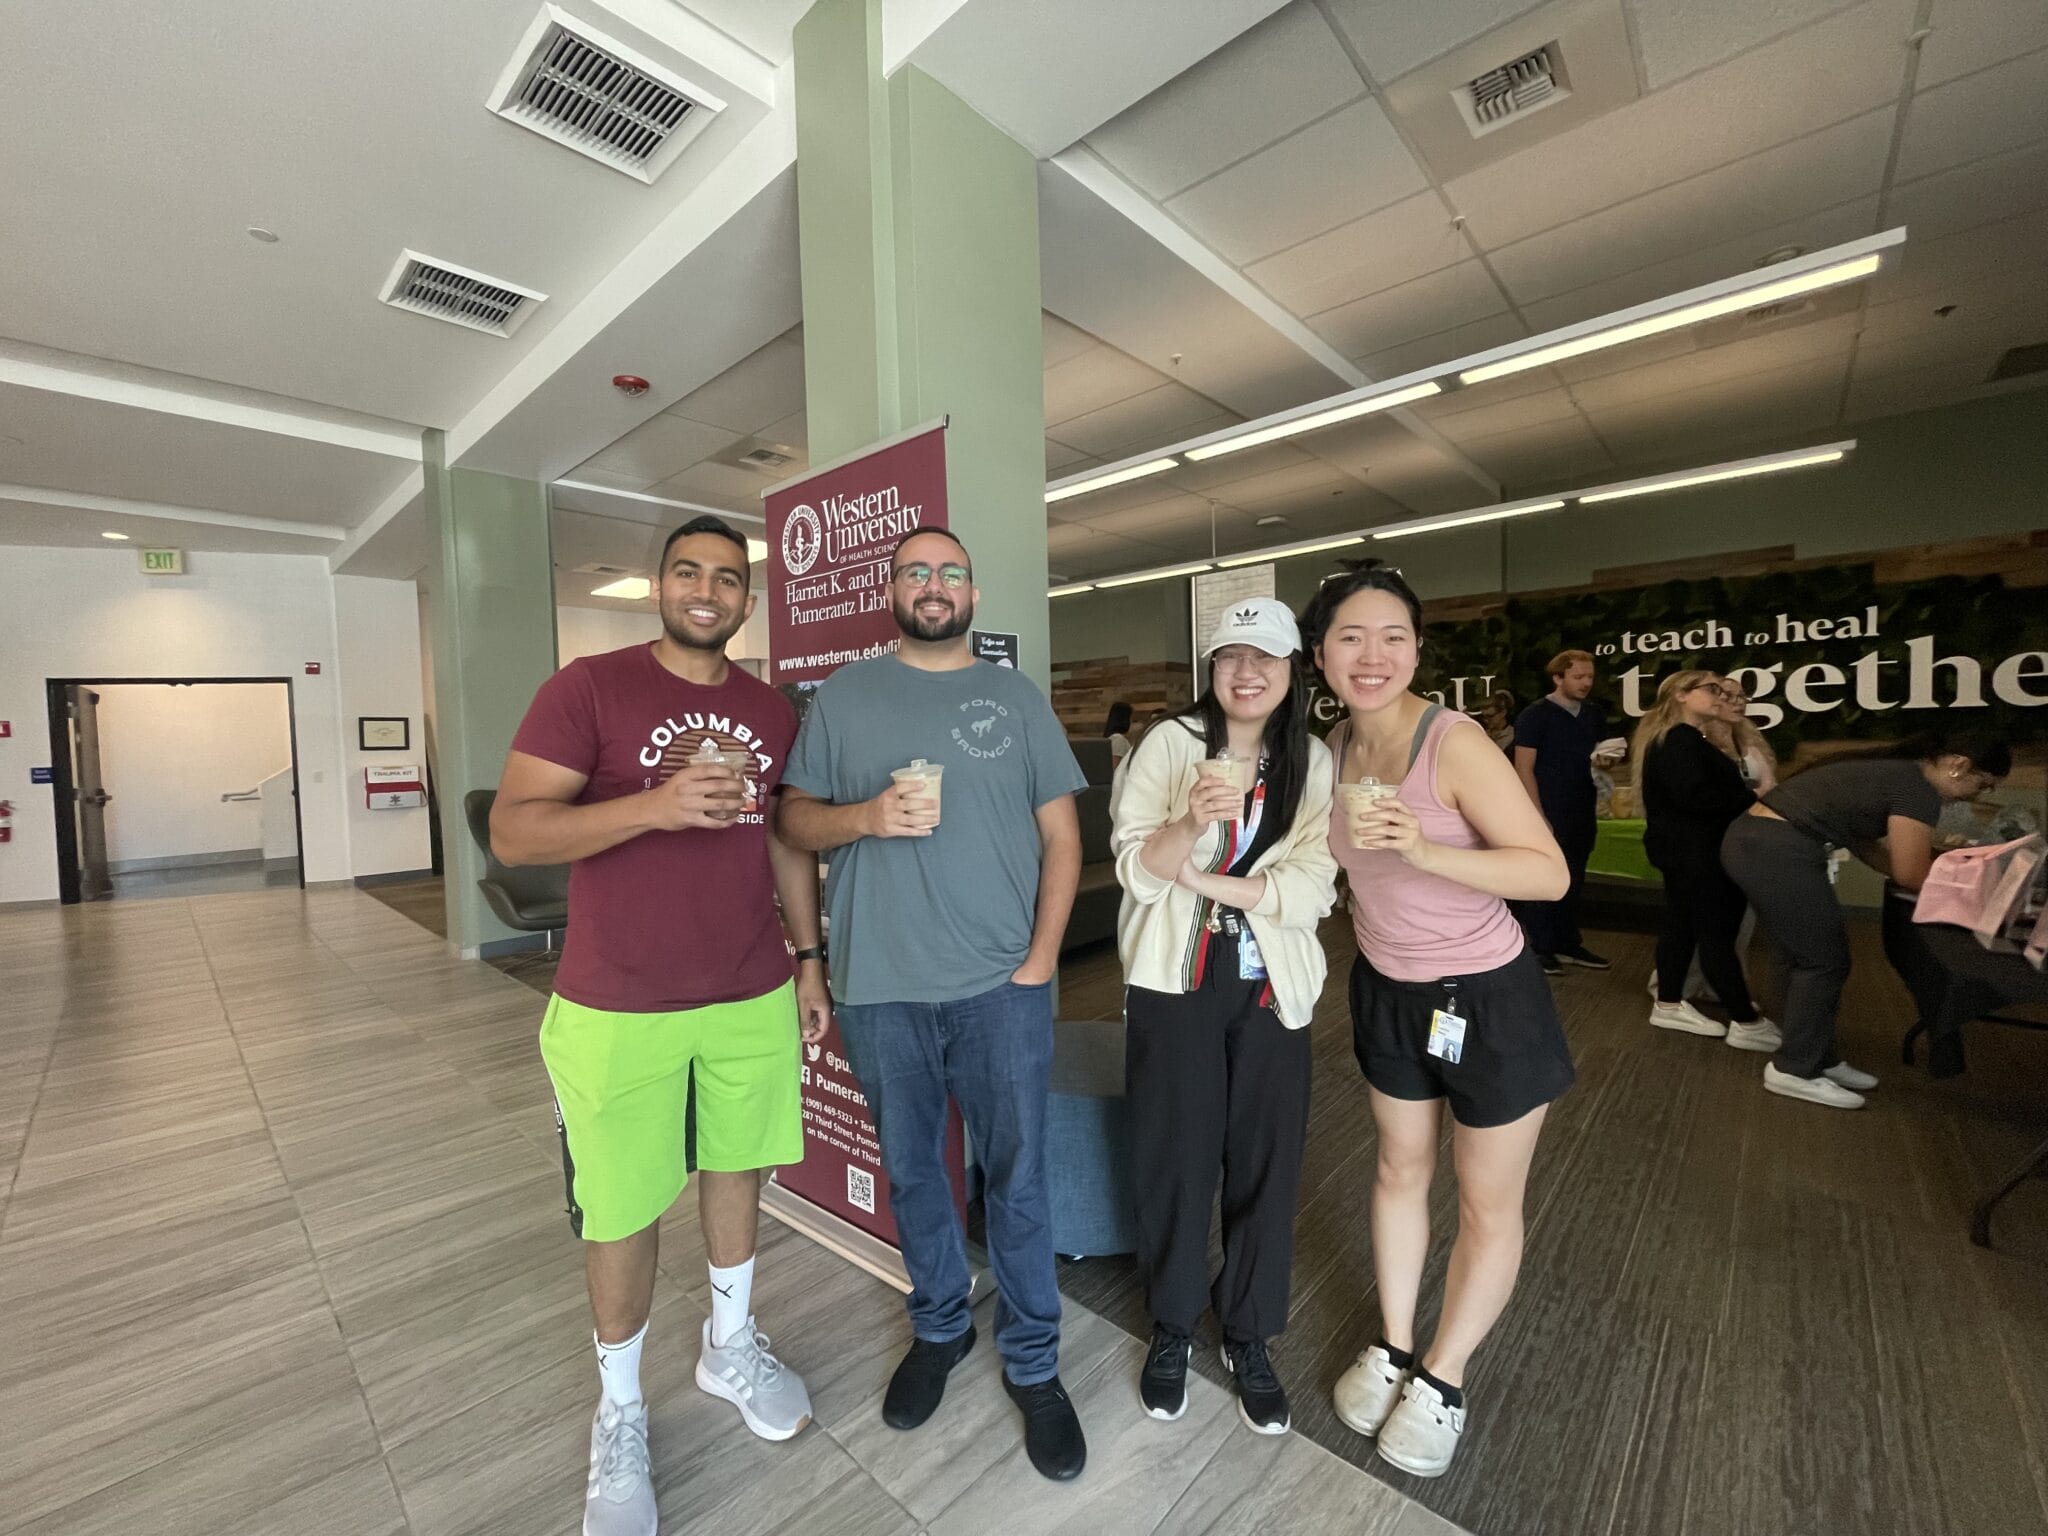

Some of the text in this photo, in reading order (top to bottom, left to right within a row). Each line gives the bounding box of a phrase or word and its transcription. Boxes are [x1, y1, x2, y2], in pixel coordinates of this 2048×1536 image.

[821, 486, 900, 531] Western
[825, 505, 922, 563] University
[145, 552, 174, 569] EXIT
[848, 549, 872, 562] HEALTH
[786, 579, 828, 605] Harriet
[829, 573, 846, 596] K.
[848, 565, 875, 591] and
[790, 600, 857, 626] Pumerantz
[1595, 605, 1880, 656] to teach to heal
[1617, 634, 2048, 731] tgethe
[960, 699, 1008, 716] FORD
[639, 713, 773, 773] COLUMBIA
[951, 727, 1011, 759] BRONCO
[806, 1097, 823, 1112] (909)
[824, 1104, 853, 1124] 469-5323
[815, 1114, 833, 1129] Third
[806, 1127, 881, 1167] on the corner of Third
